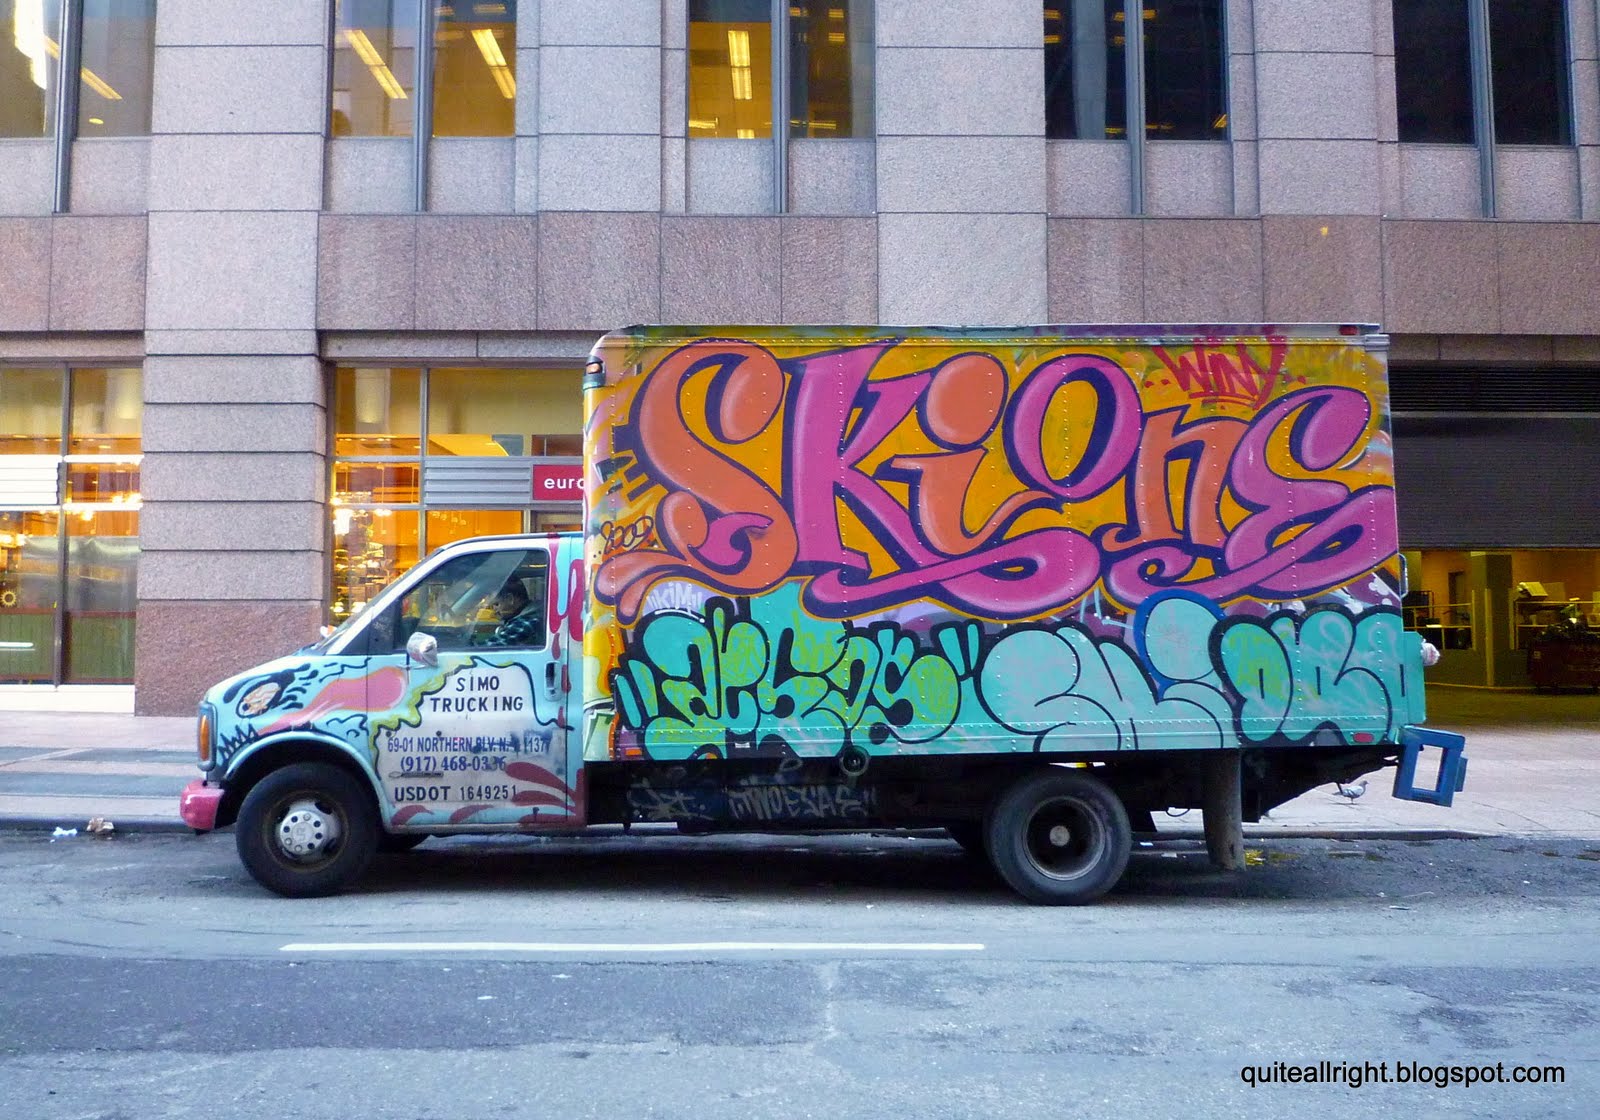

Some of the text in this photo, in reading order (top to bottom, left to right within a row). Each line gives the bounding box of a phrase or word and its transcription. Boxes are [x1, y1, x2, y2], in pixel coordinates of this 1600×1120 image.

[456, 675, 500, 692] SIMO
[430, 696, 523, 713] TRUCKING
[388, 737, 414, 753] 69-01
[417, 737, 472, 753] NORTHERN
[400, 755, 437, 773] (917)
[394, 784, 517, 802] USDOT 1649251
